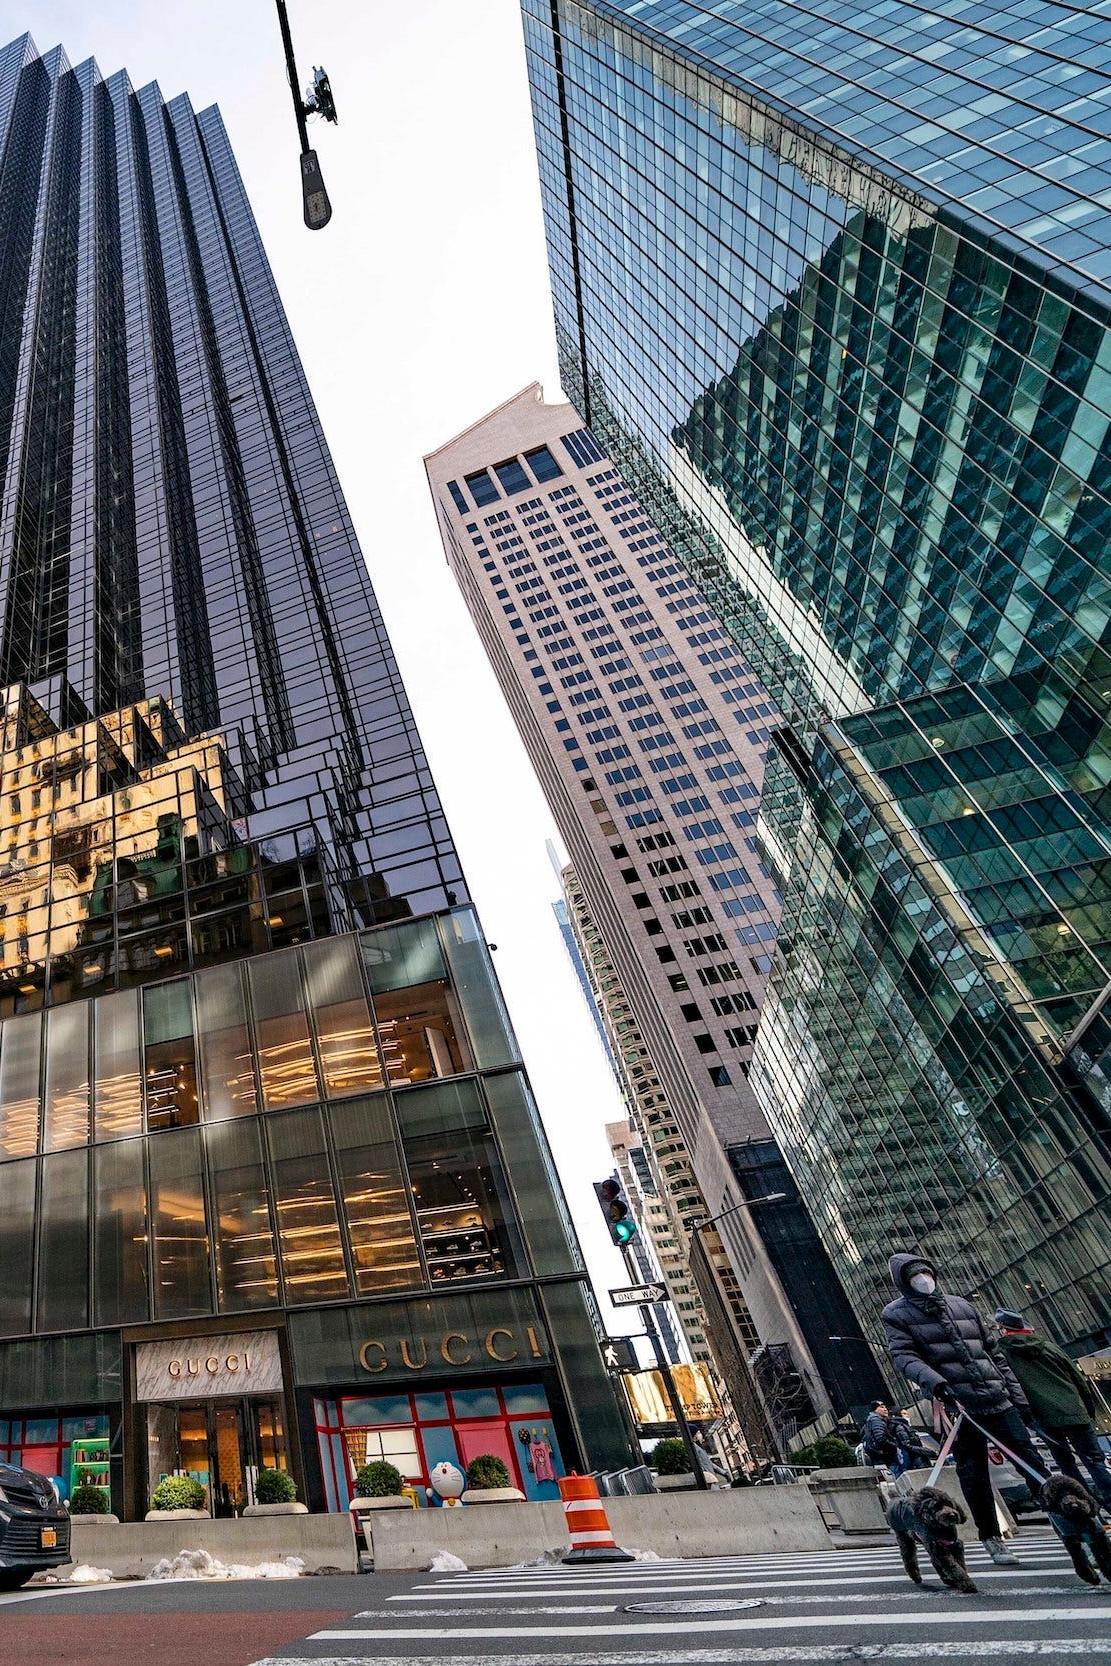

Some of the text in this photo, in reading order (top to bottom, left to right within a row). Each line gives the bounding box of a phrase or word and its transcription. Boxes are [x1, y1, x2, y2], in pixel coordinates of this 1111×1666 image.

[617, 1289, 660, 1302] ONE WAY
[358, 1326, 542, 1374] GUCCI
[168, 1353, 250, 1377] GUCCI
